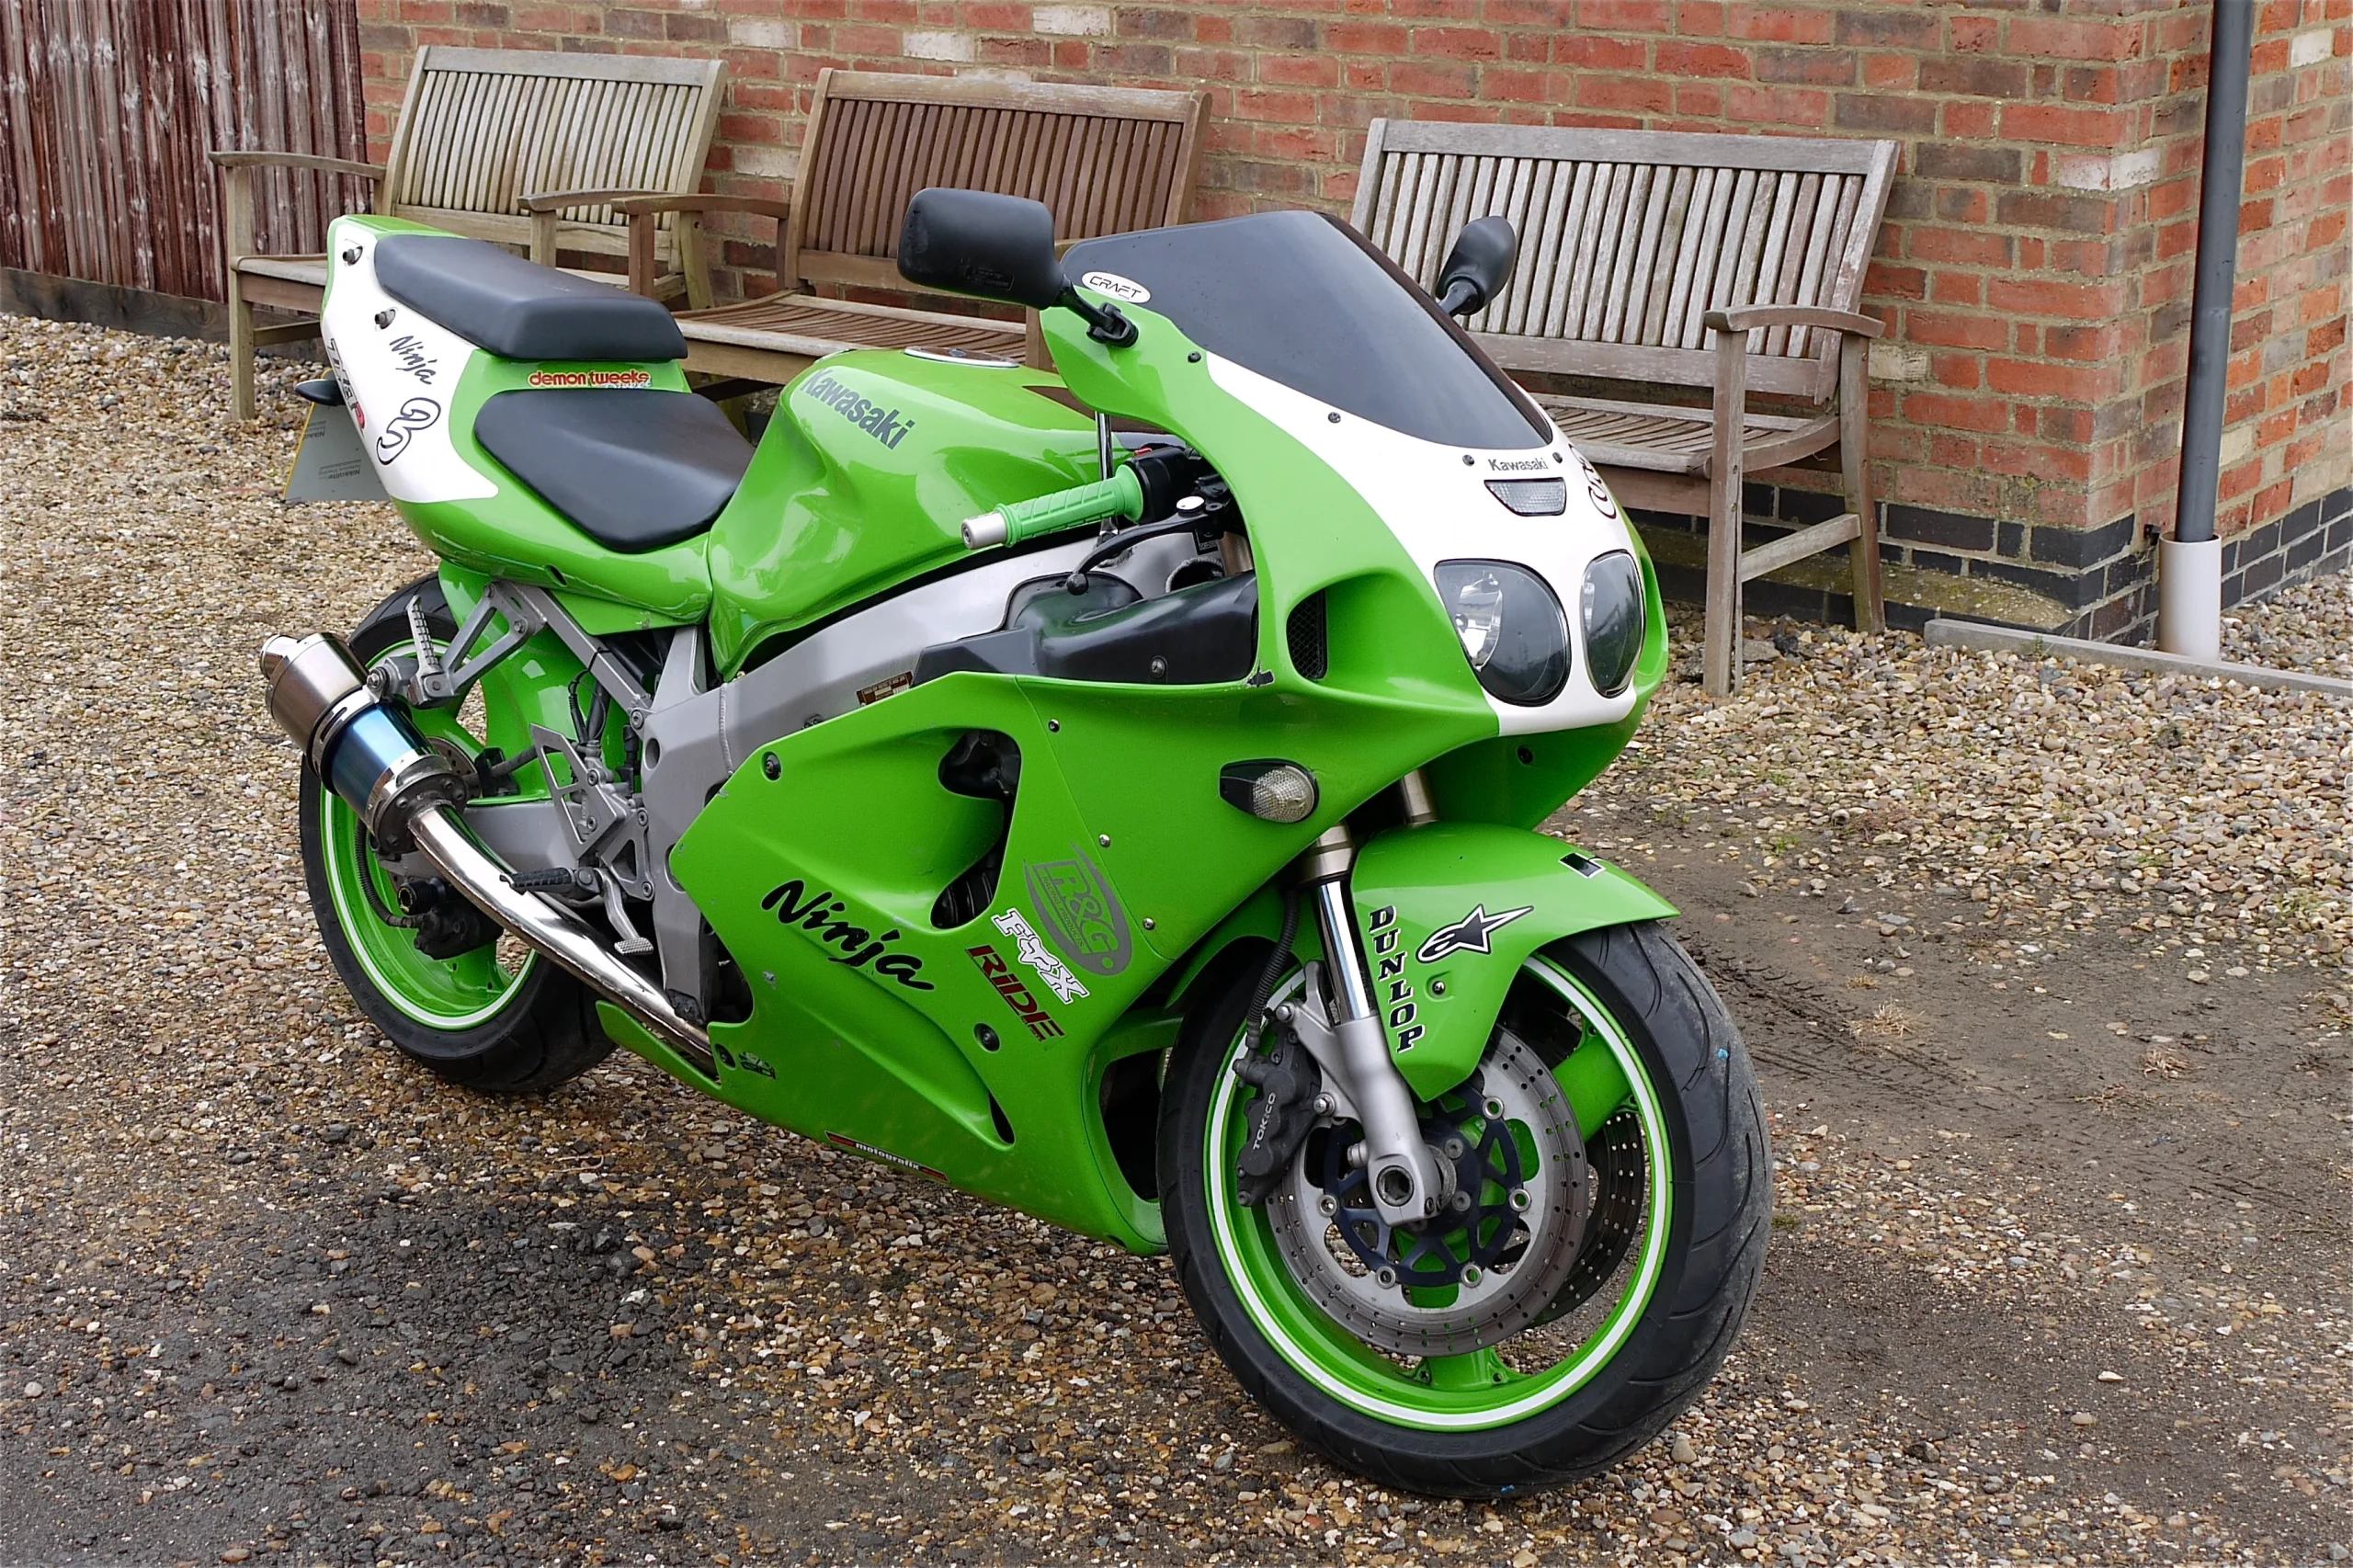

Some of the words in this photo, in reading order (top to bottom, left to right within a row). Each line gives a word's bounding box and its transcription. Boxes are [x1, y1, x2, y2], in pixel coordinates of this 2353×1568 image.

[1089, 276, 1142, 299] CRAFT
[389, 335, 438, 385] Ninja
[529, 371, 586, 386] demon
[588, 369, 650, 385] tweeks
[801, 368, 915, 450] Kawasaki
[1487, 458, 1549, 472] Kawasaki
[761, 880, 935, 990] Ninja
[1041, 876, 1061, 907] RACING
[1058, 907, 1085, 948] PRODUCTS
[1369, 905, 1426, 1053] DUNLOP
[1253, 1092, 1276, 1151] TOKICO
